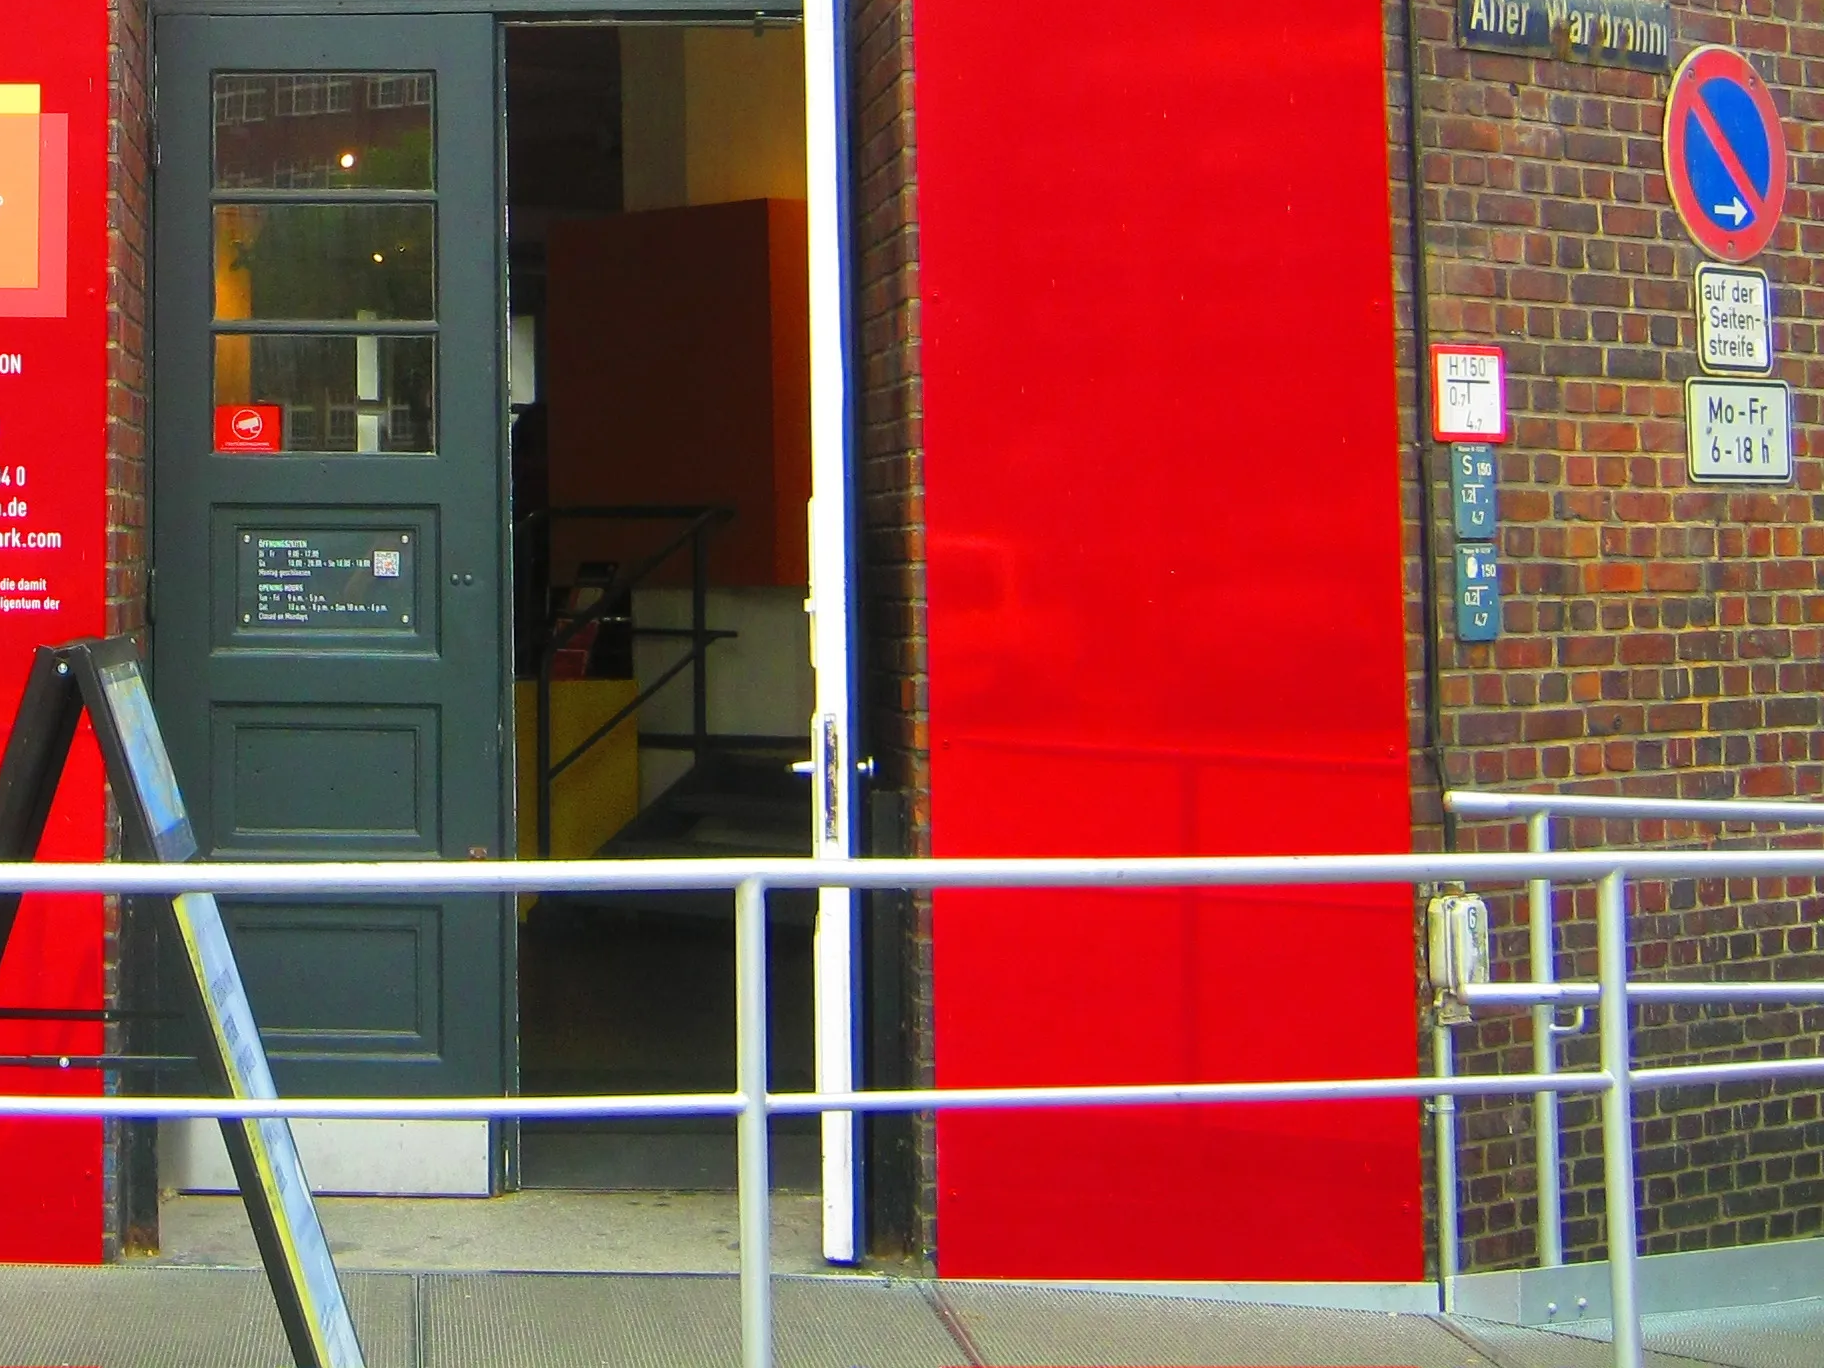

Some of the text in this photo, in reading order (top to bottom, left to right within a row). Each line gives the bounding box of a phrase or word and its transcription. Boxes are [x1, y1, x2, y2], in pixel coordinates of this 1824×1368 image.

[1704, 279, 1754, 303] auf der
[1709, 305, 1761, 330] Seiten-
[1761, 437, 1770, 464] h
[1462, 455, 1472, 475] S
[16, 466, 26, 486] 0
[0, 577, 15, 590] die
[18, 578, 47, 591] damit
[44, 597, 61, 610] der
